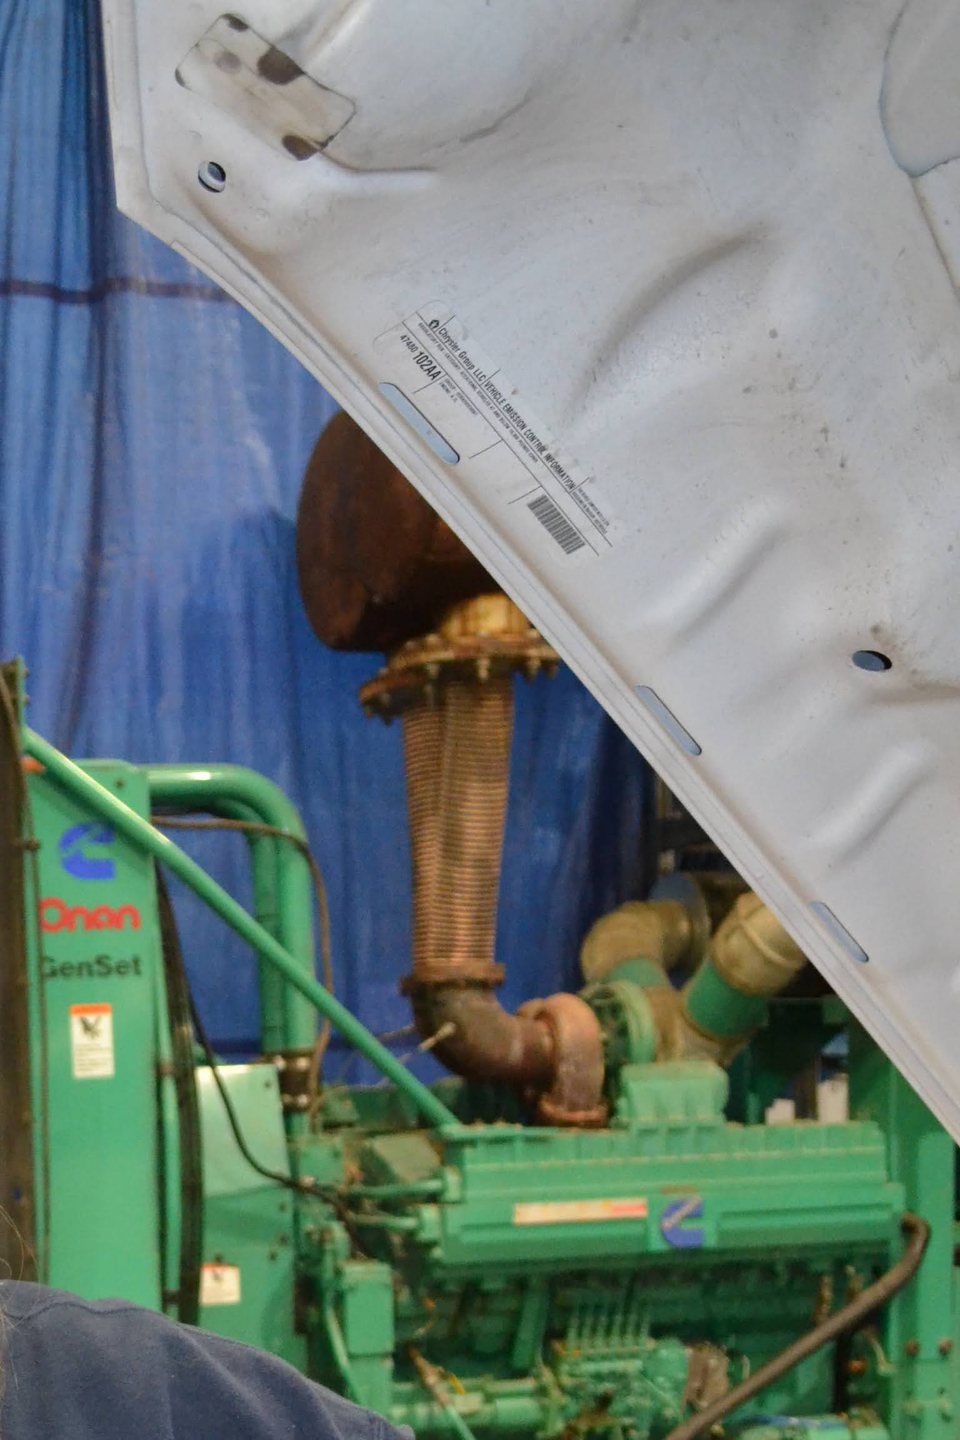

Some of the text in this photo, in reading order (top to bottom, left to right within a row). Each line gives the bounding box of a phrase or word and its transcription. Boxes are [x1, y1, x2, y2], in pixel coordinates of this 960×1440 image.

[412, 351, 441, 381] 102AA
[438, 327, 460, 352] Chrysler
[458, 350, 474, 369] Group
[473, 368, 486, 382] LLC
[483, 380, 506, 406] VEHICLE
[501, 402, 528, 431] EMISSION
[523, 428, 547, 455] CONTROL
[543, 452, 576, 490] INFORMATION
[40, 896, 141, 933] Onan
[41, 954, 141, 978] GenSet
